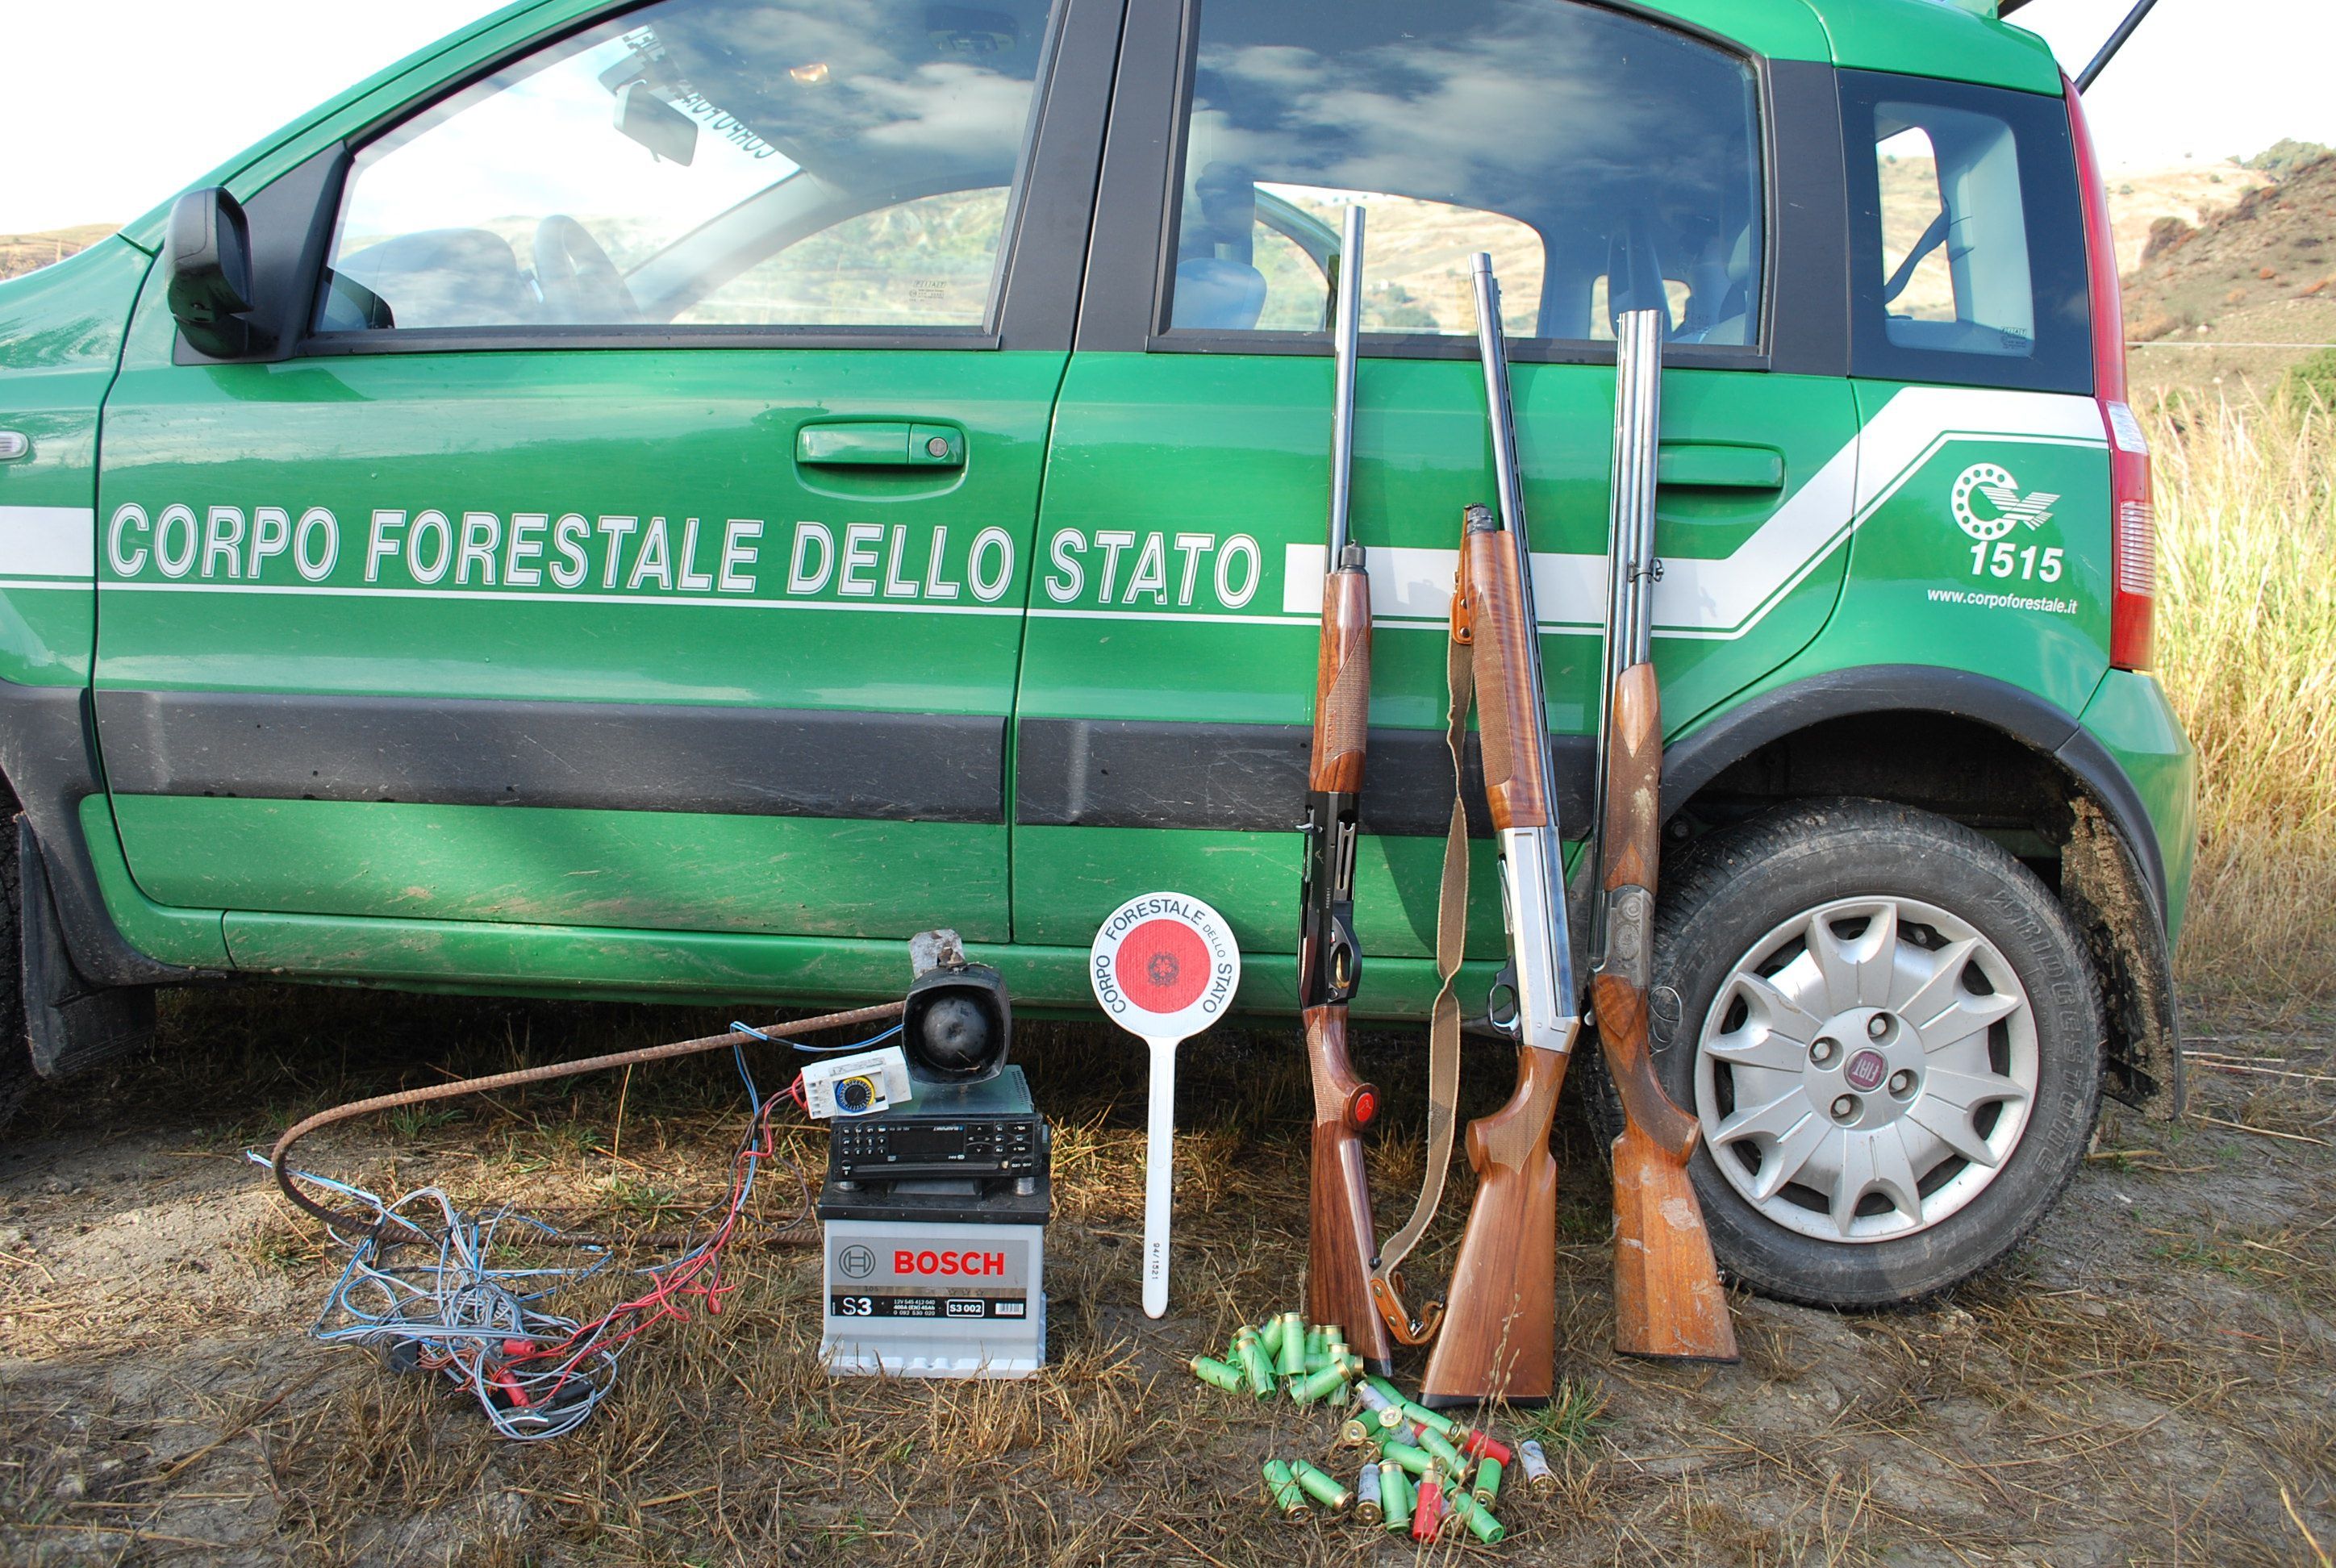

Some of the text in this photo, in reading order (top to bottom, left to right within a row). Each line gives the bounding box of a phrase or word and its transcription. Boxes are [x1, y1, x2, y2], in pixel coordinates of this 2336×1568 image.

[107, 503, 1262, 609] CORPO FORESTALE DELLO STATO
[1971, 540, 2064, 583] 1515
[1927, 589, 2079, 615] www.corpoforestale.it
[1095, 899, 1233, 1014] CORPO FORESTALE DELLO STATO
[1852, 1058, 1880, 1082] FIAT
[894, 1250, 1005, 1276] BOSCH
[842, 1297, 872, 1316] S3
[949, 1303, 982, 1313] S3 002
